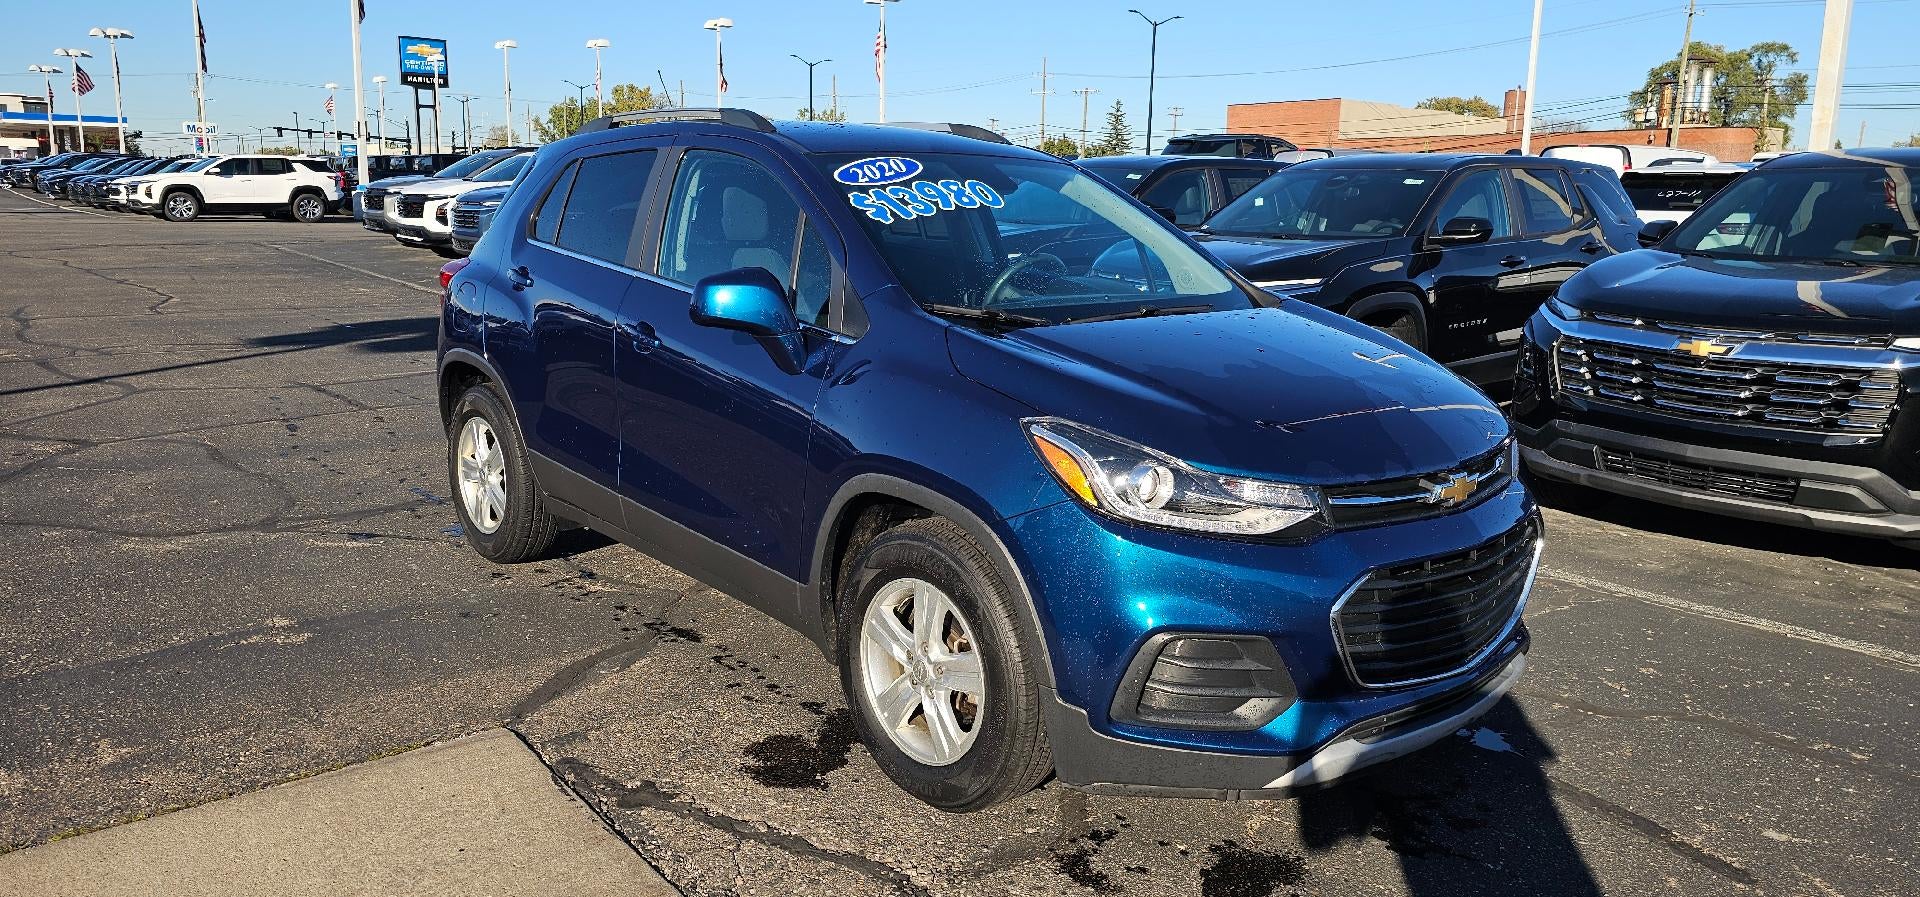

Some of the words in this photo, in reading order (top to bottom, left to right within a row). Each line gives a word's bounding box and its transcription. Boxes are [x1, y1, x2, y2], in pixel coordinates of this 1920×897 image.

[407, 64, 444, 72] PRE-OWND
[850, 158, 907, 183] 2020
[848, 179, 1005, 224] $13980
